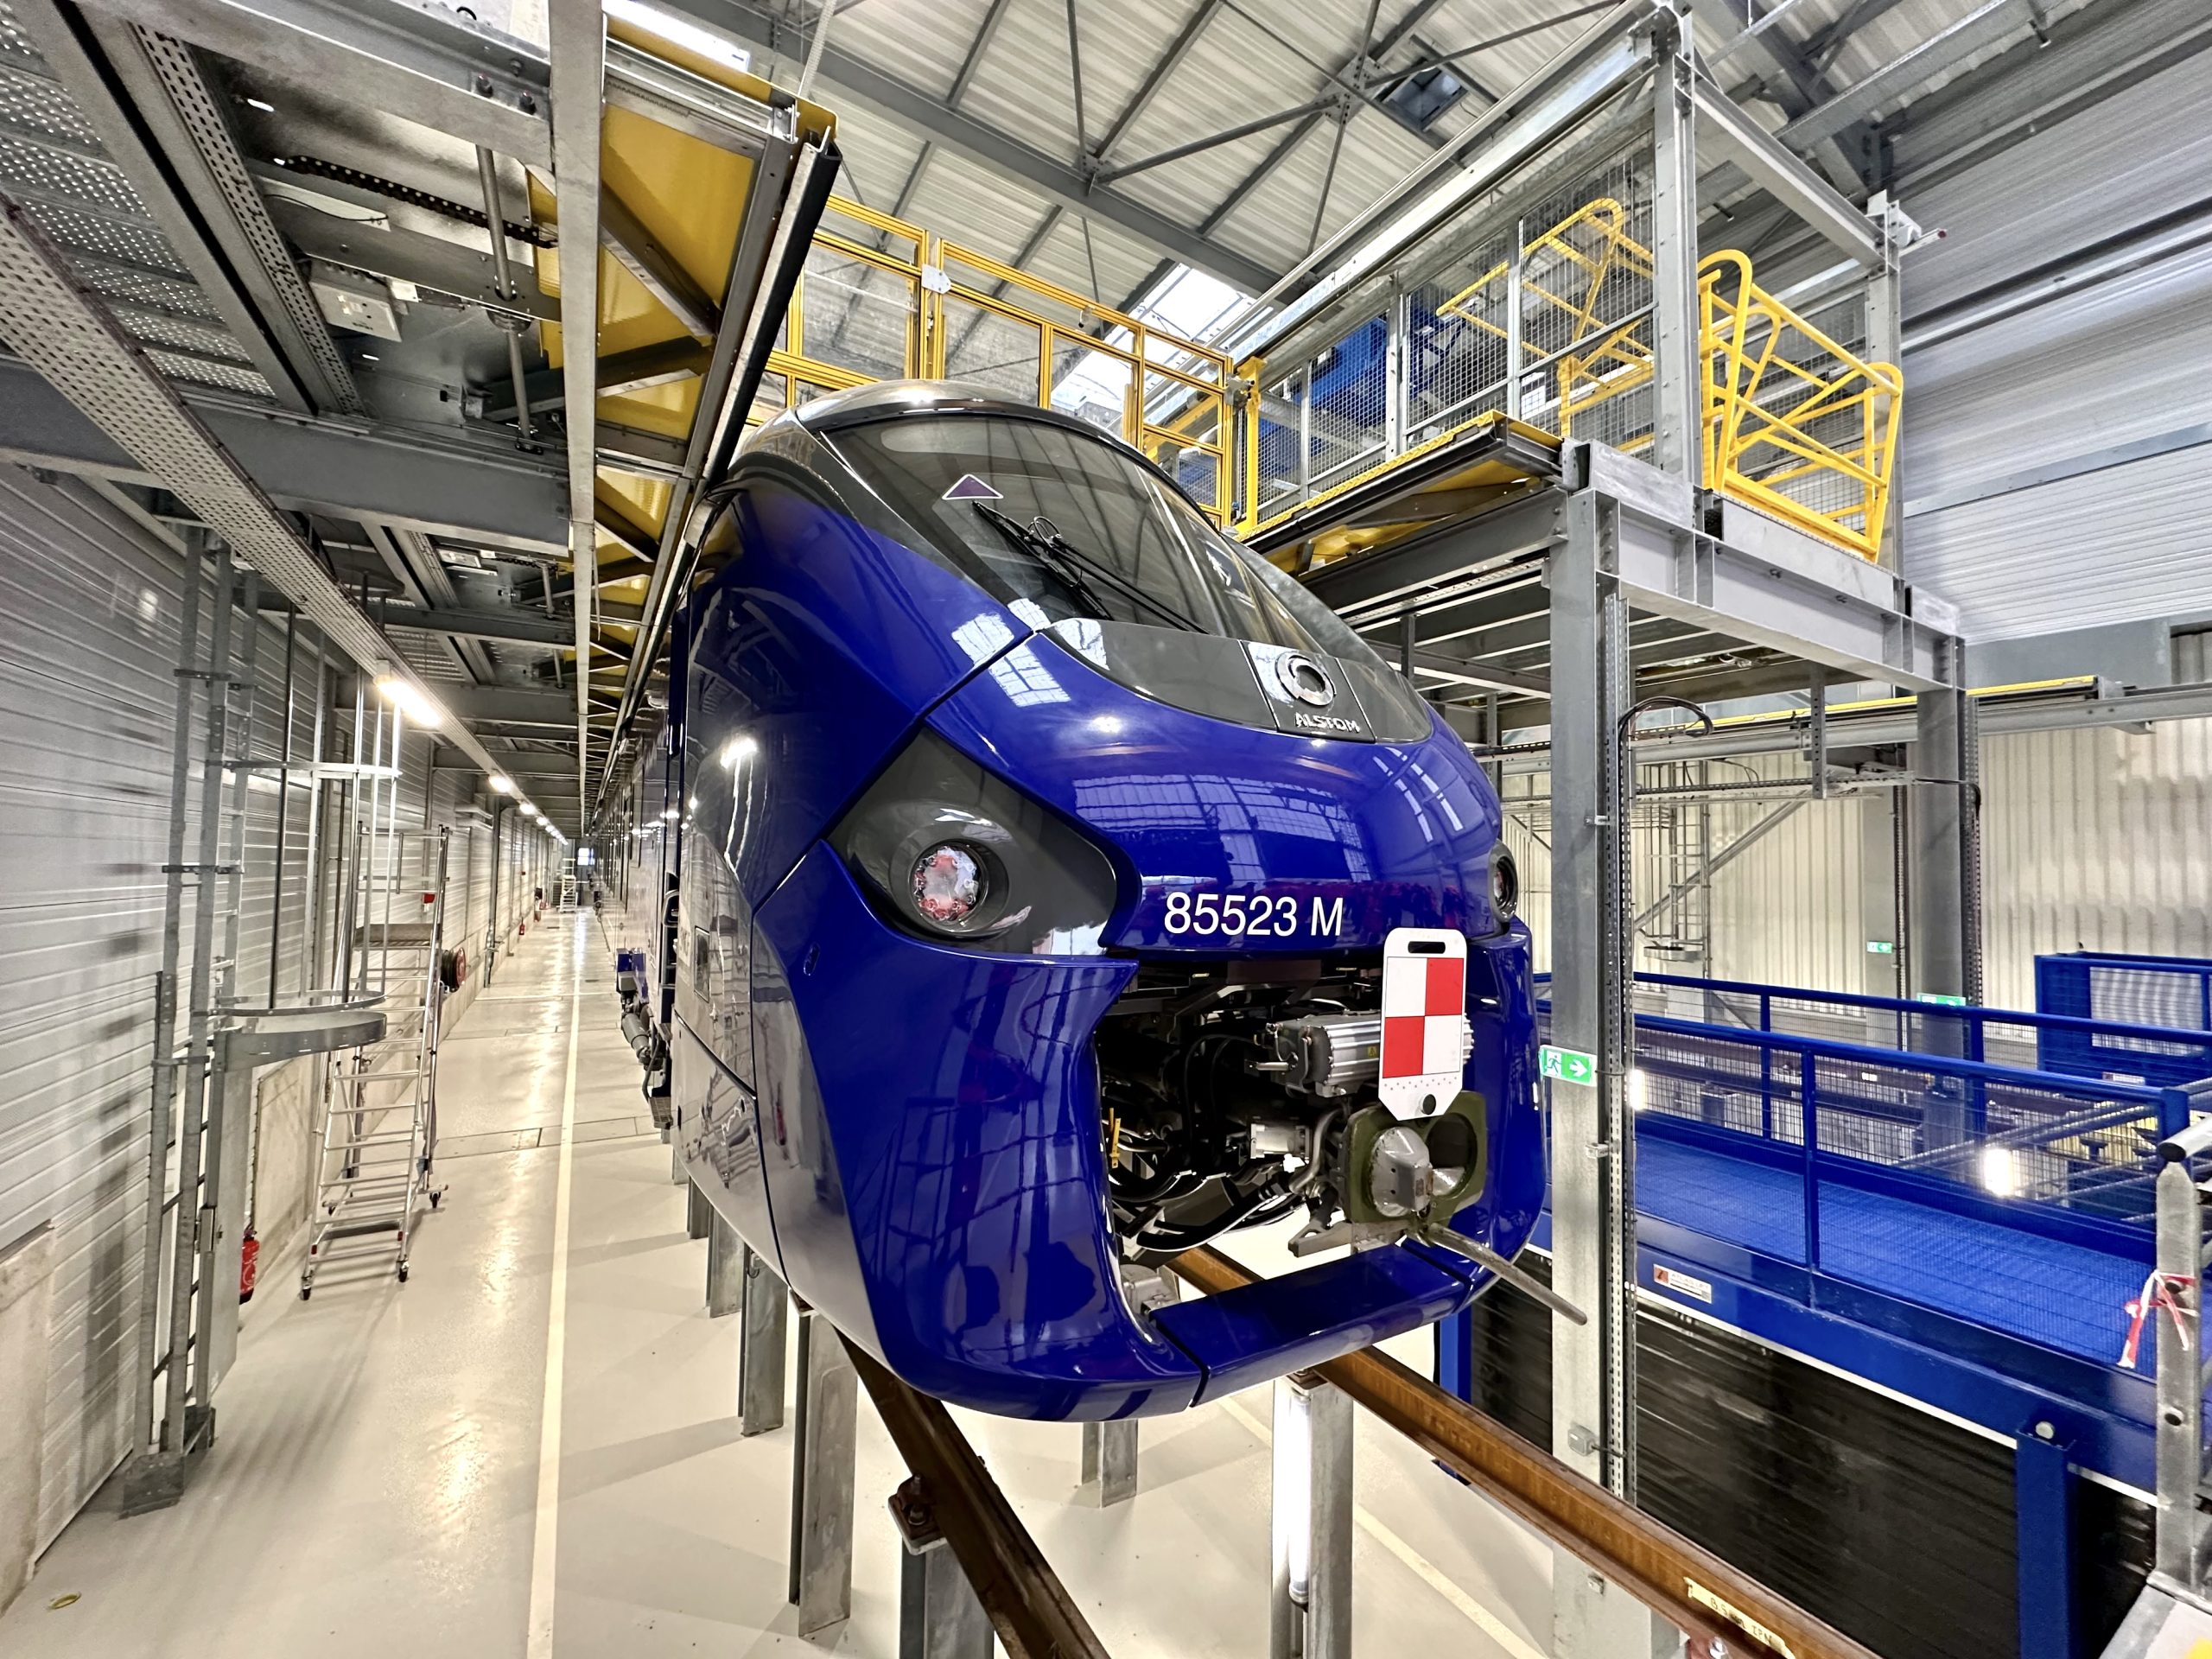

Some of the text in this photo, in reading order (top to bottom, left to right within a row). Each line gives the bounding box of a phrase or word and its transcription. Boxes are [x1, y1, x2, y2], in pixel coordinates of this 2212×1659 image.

[1295, 712, 1361, 733] ALSTOM
[1164, 891, 1344, 938] 85523 M
